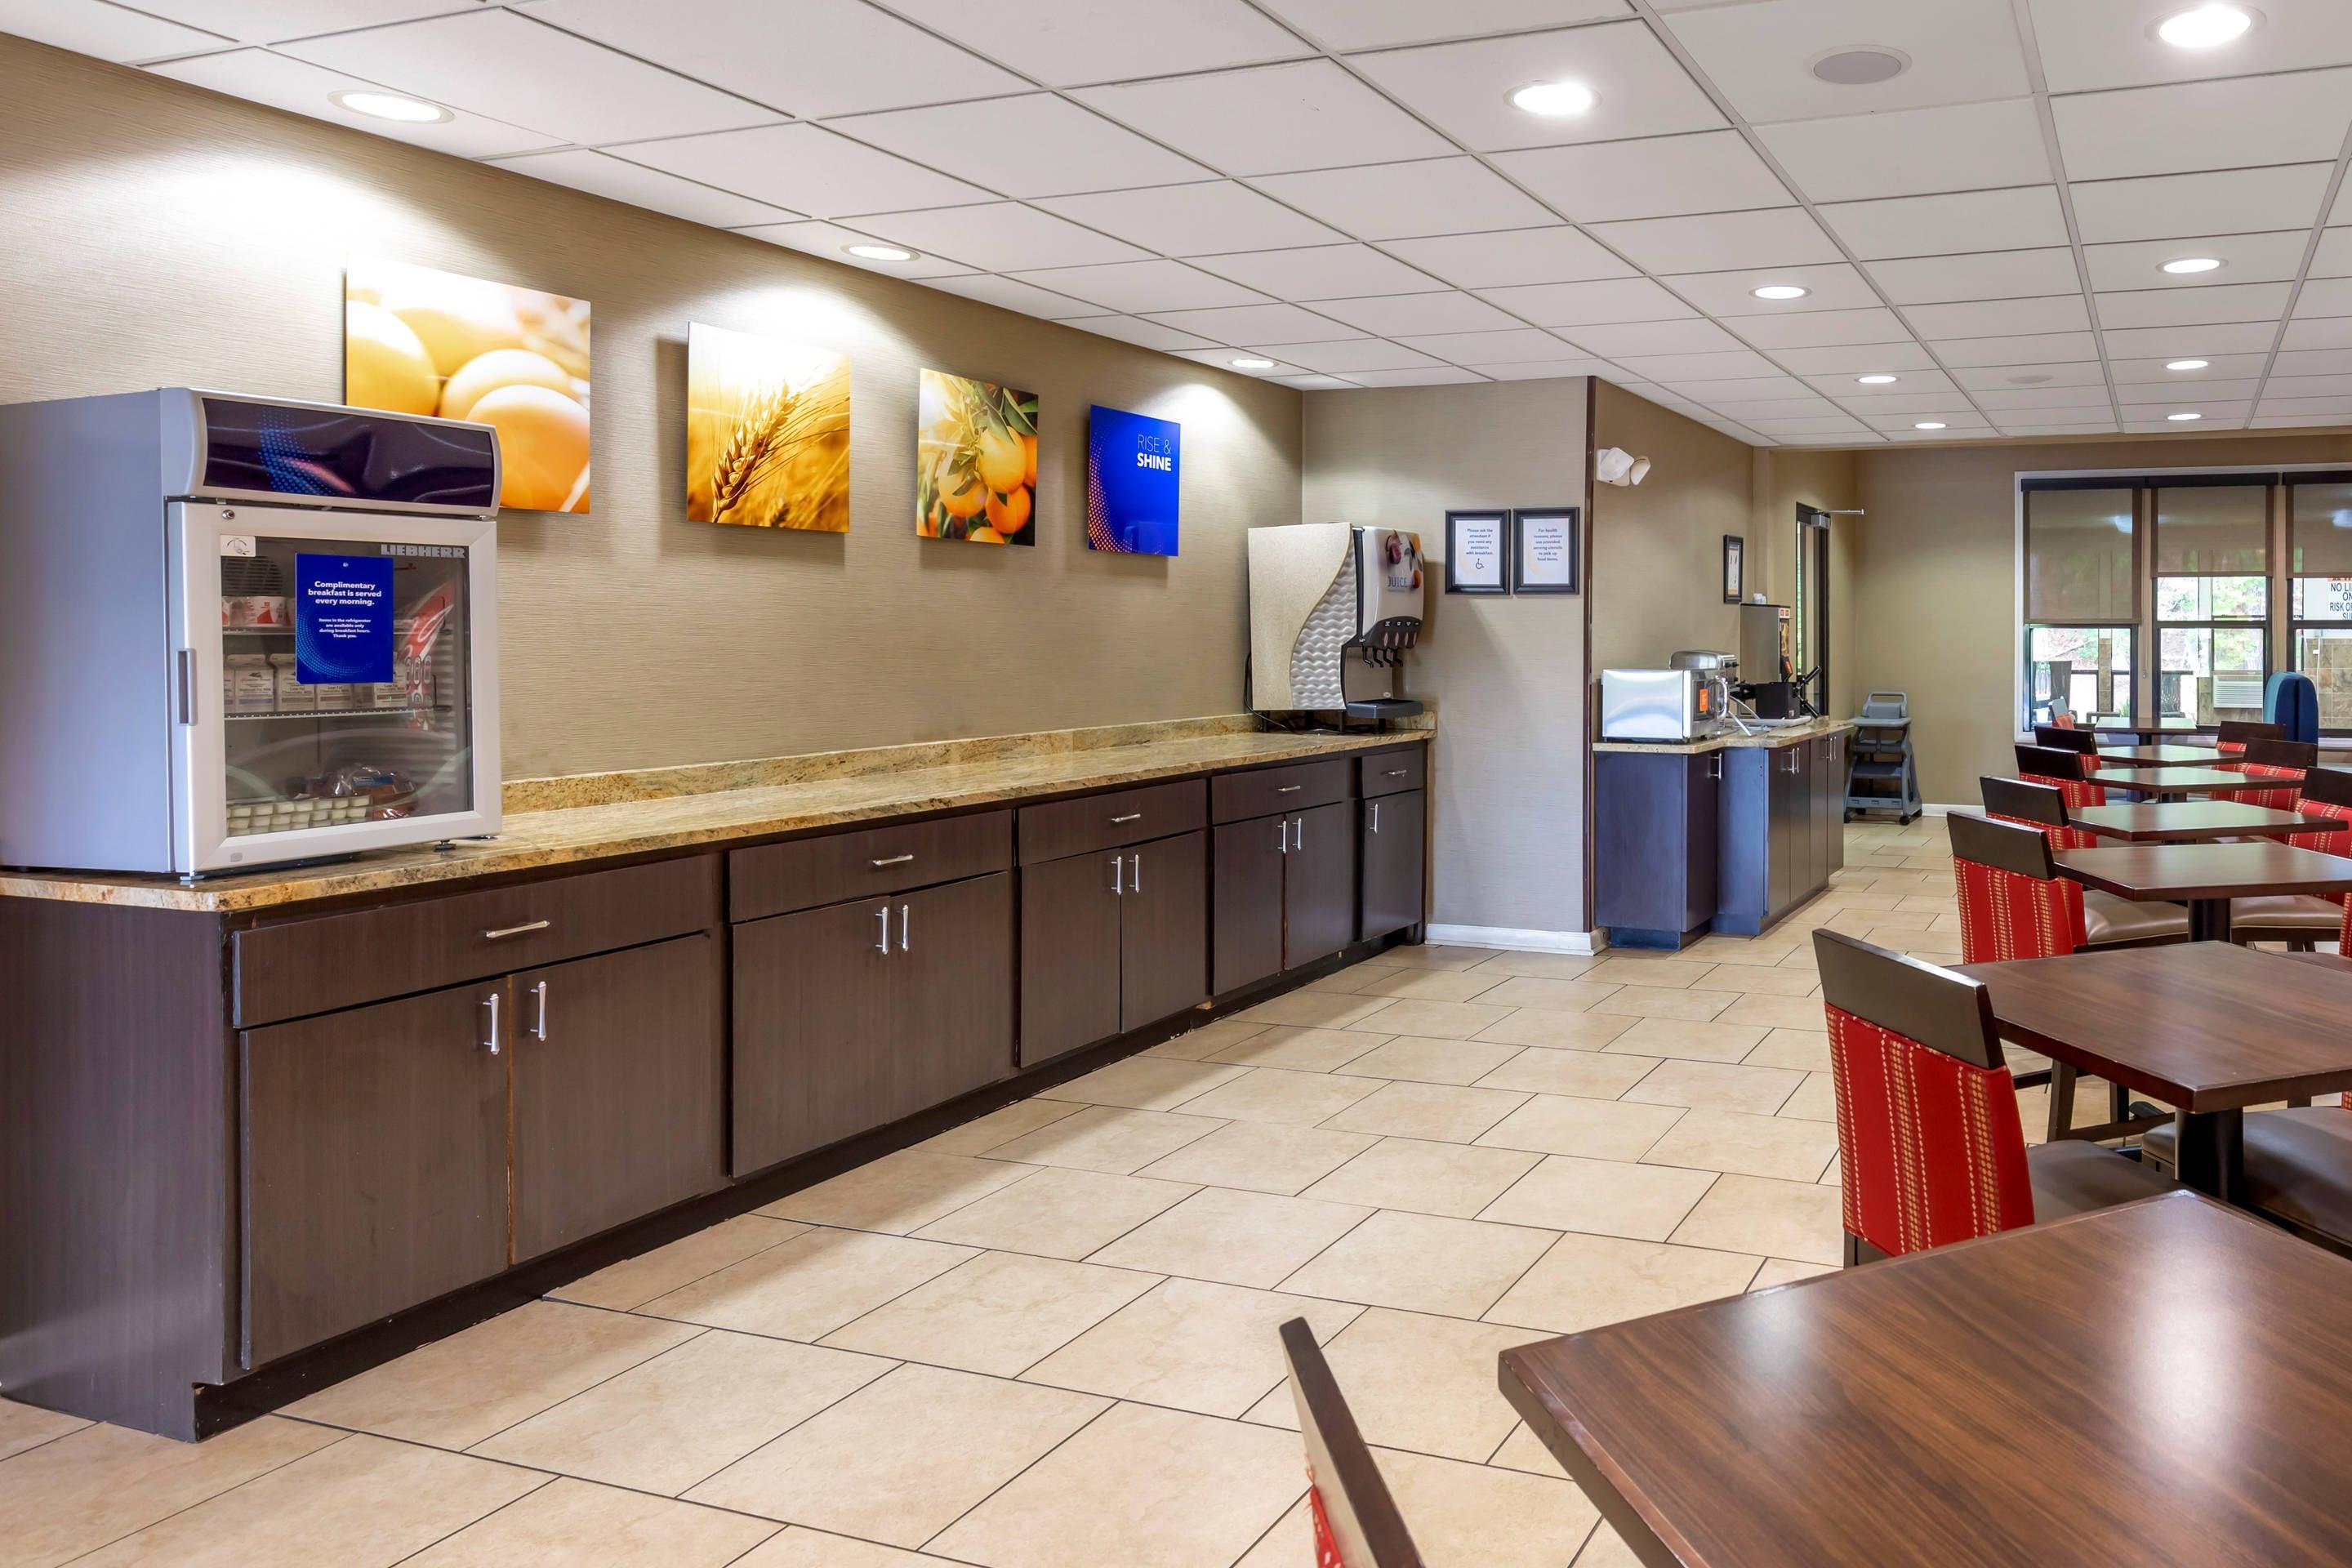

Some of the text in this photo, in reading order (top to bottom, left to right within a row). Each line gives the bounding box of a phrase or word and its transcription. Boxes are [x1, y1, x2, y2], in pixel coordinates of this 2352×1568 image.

[1138, 434, 1171, 455] RISE &
[1137, 452, 1172, 471] SHINE
[381, 544, 466, 559] LIEBHERR
[314, 581, 376, 590] Complimentary
[1387, 576, 1406, 588] JUICE
[2330, 582, 2342, 592] NO
[308, 588, 346, 596] breakfast
[339, 598, 375, 607] morning.
[2329, 602, 2344, 612] RISK
